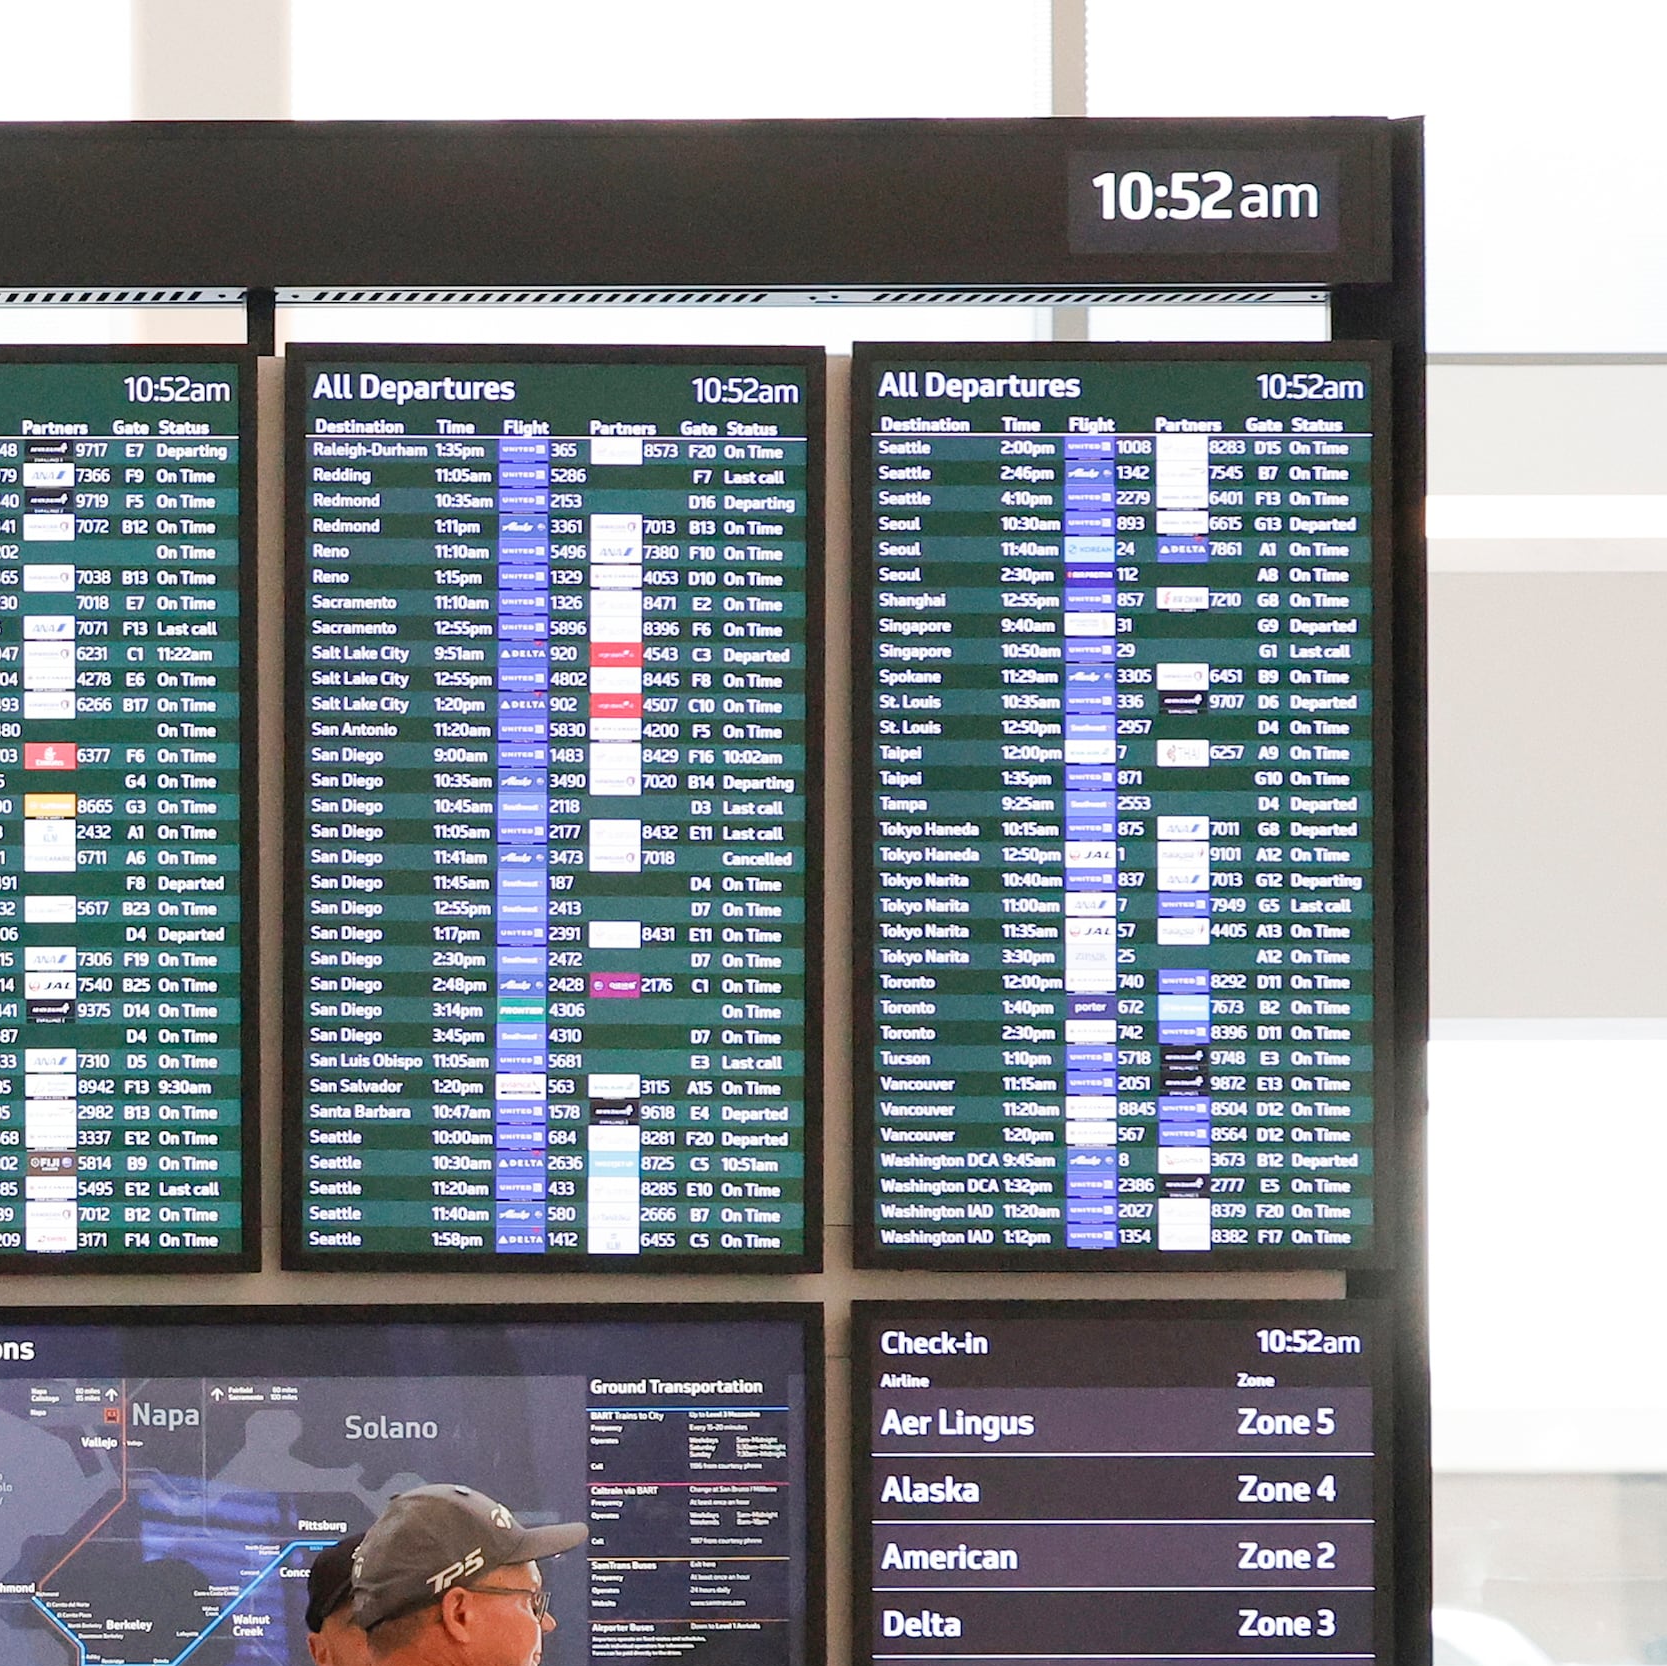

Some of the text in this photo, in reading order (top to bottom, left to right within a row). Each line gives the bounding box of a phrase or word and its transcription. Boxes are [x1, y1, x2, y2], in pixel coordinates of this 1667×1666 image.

[123, 376, 231, 403] 10:52am
[878, 371, 1081, 404] All Departures
[1256, 373, 1364, 400] 10:52am
[313, 467, 372, 485] Redding
[434, 467, 492, 483] 11:05am
[550, 468, 587, 483] 5286
[693, 469, 713, 484] F7
[723, 469, 757, 485] Last
[757, 470, 785, 485] call
[881, 1328, 1361, 1355] Check-in 10:52am
[132, 1402, 200, 1432] Napa
[345, 1415, 438, 1440] Solano
[880, 1407, 1335, 1442] Aer Lingus Zone 5
[881, 1541, 1336, 1571] American Zone 2
